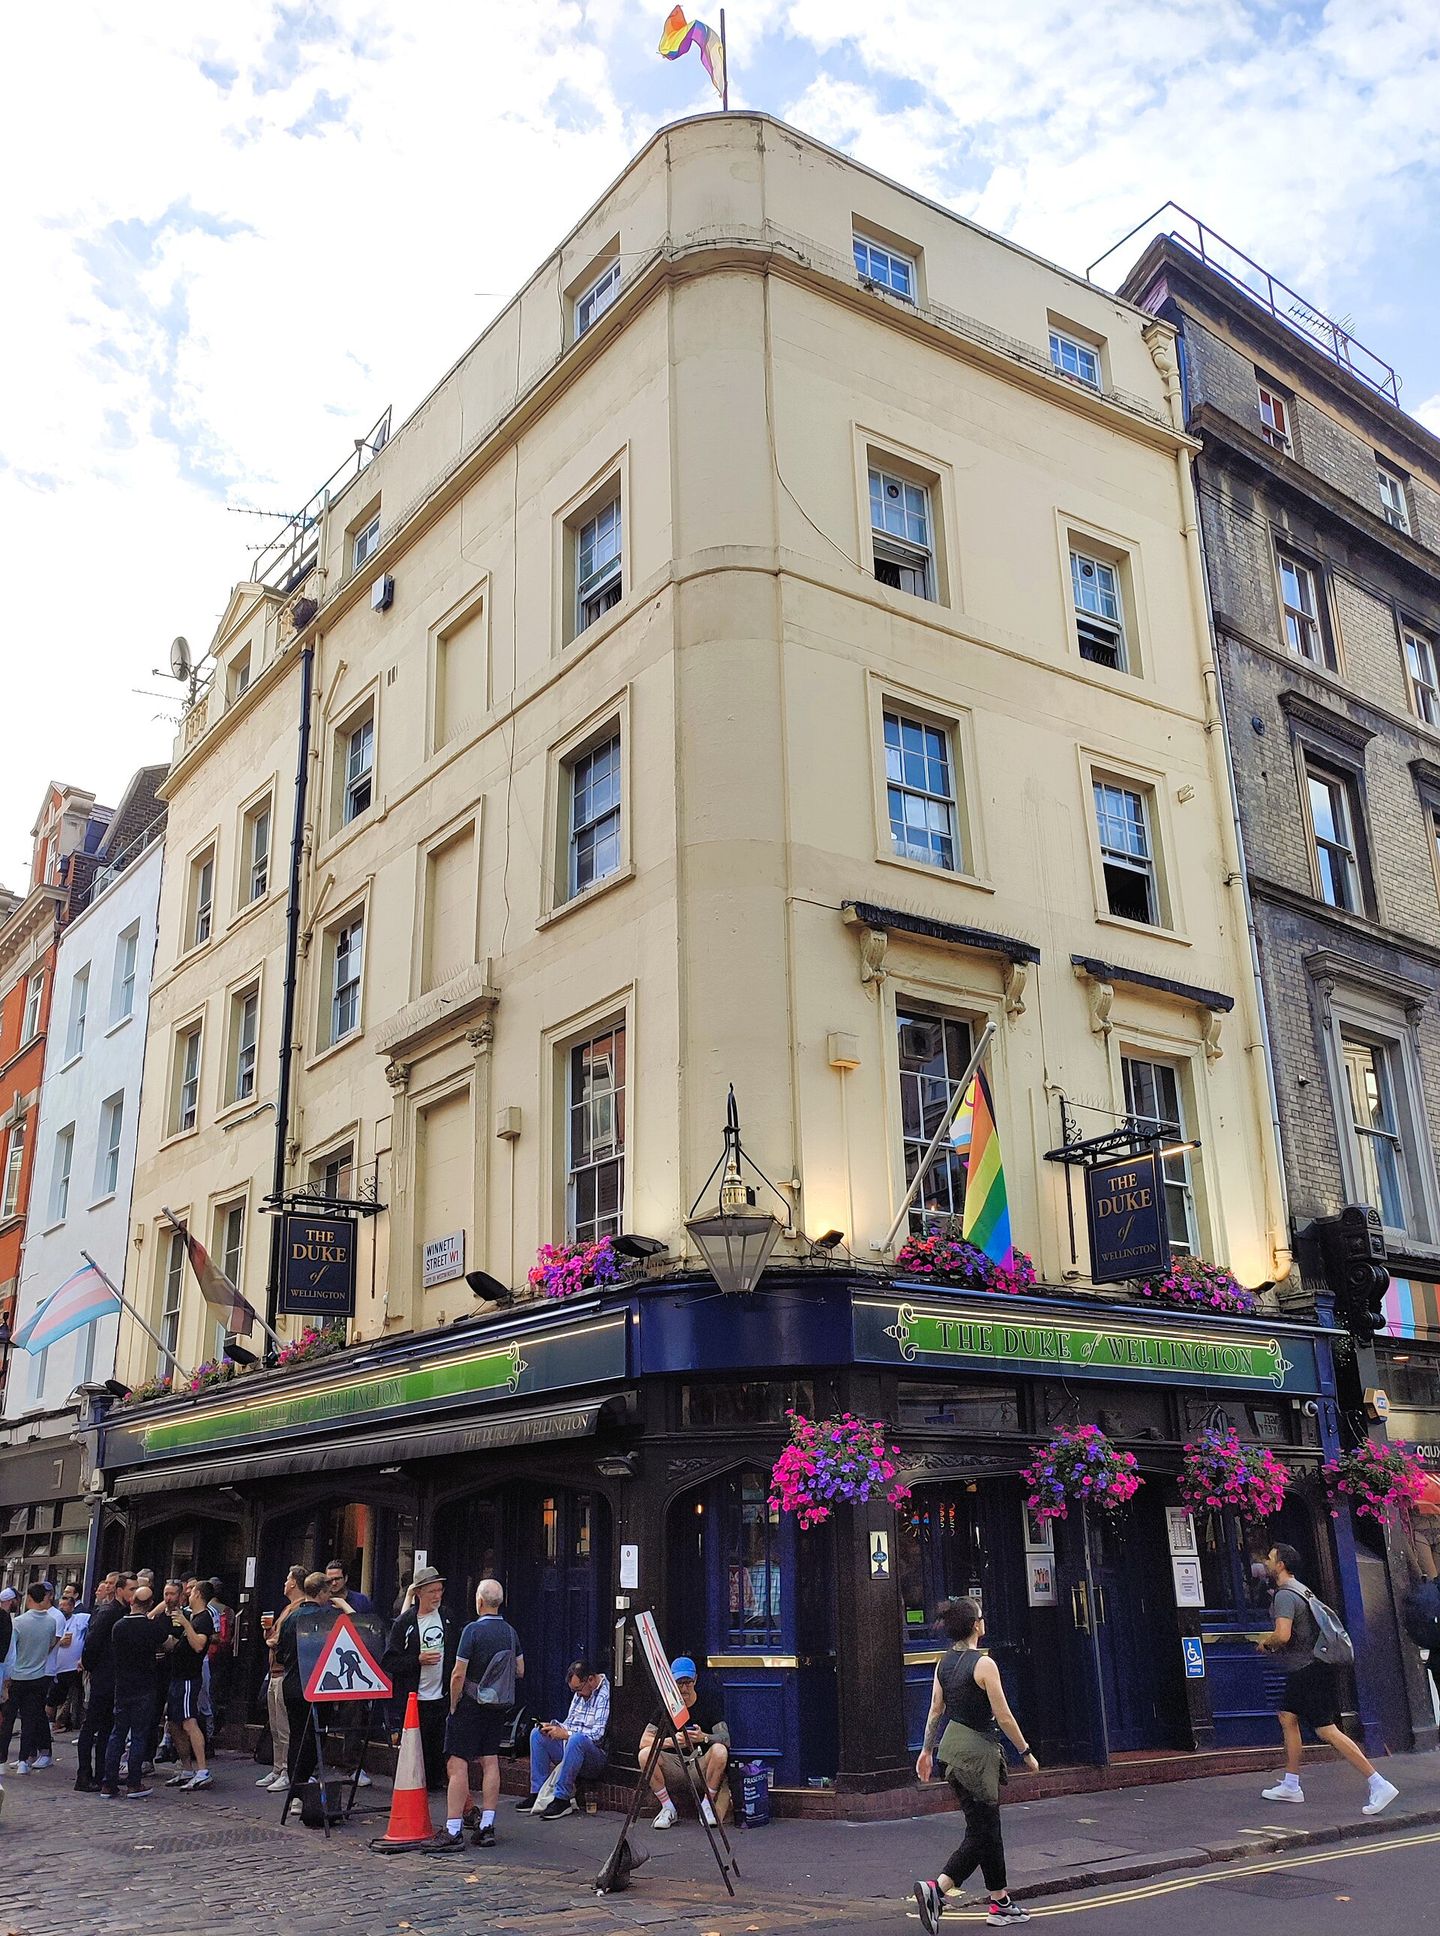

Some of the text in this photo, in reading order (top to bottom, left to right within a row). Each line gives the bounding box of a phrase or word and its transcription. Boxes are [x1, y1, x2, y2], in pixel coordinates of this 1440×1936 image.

[1108, 1173, 1138, 1192] THE
[1097, 1188, 1153, 1218] DUKE
[305, 1229, 335, 1243] THE
[1118, 1215, 1135, 1244] of
[291, 1243, 347, 1263] DUKE
[426, 1237, 454, 1257] WINNETT
[1102, 1244, 1157, 1261] WELLINGTON
[426, 1250, 459, 1271] STREET W1
[309, 1264, 329, 1287] of
[290, 1288, 346, 1299] WELLINGTON
[936, 1320, 1255, 1375] THE DUKE of WELLINGTON
[463, 1430, 481, 1445] THE
[482, 1424, 510, 1442] DUKE
[523, 1414, 589, 1436] WELLINGTON
